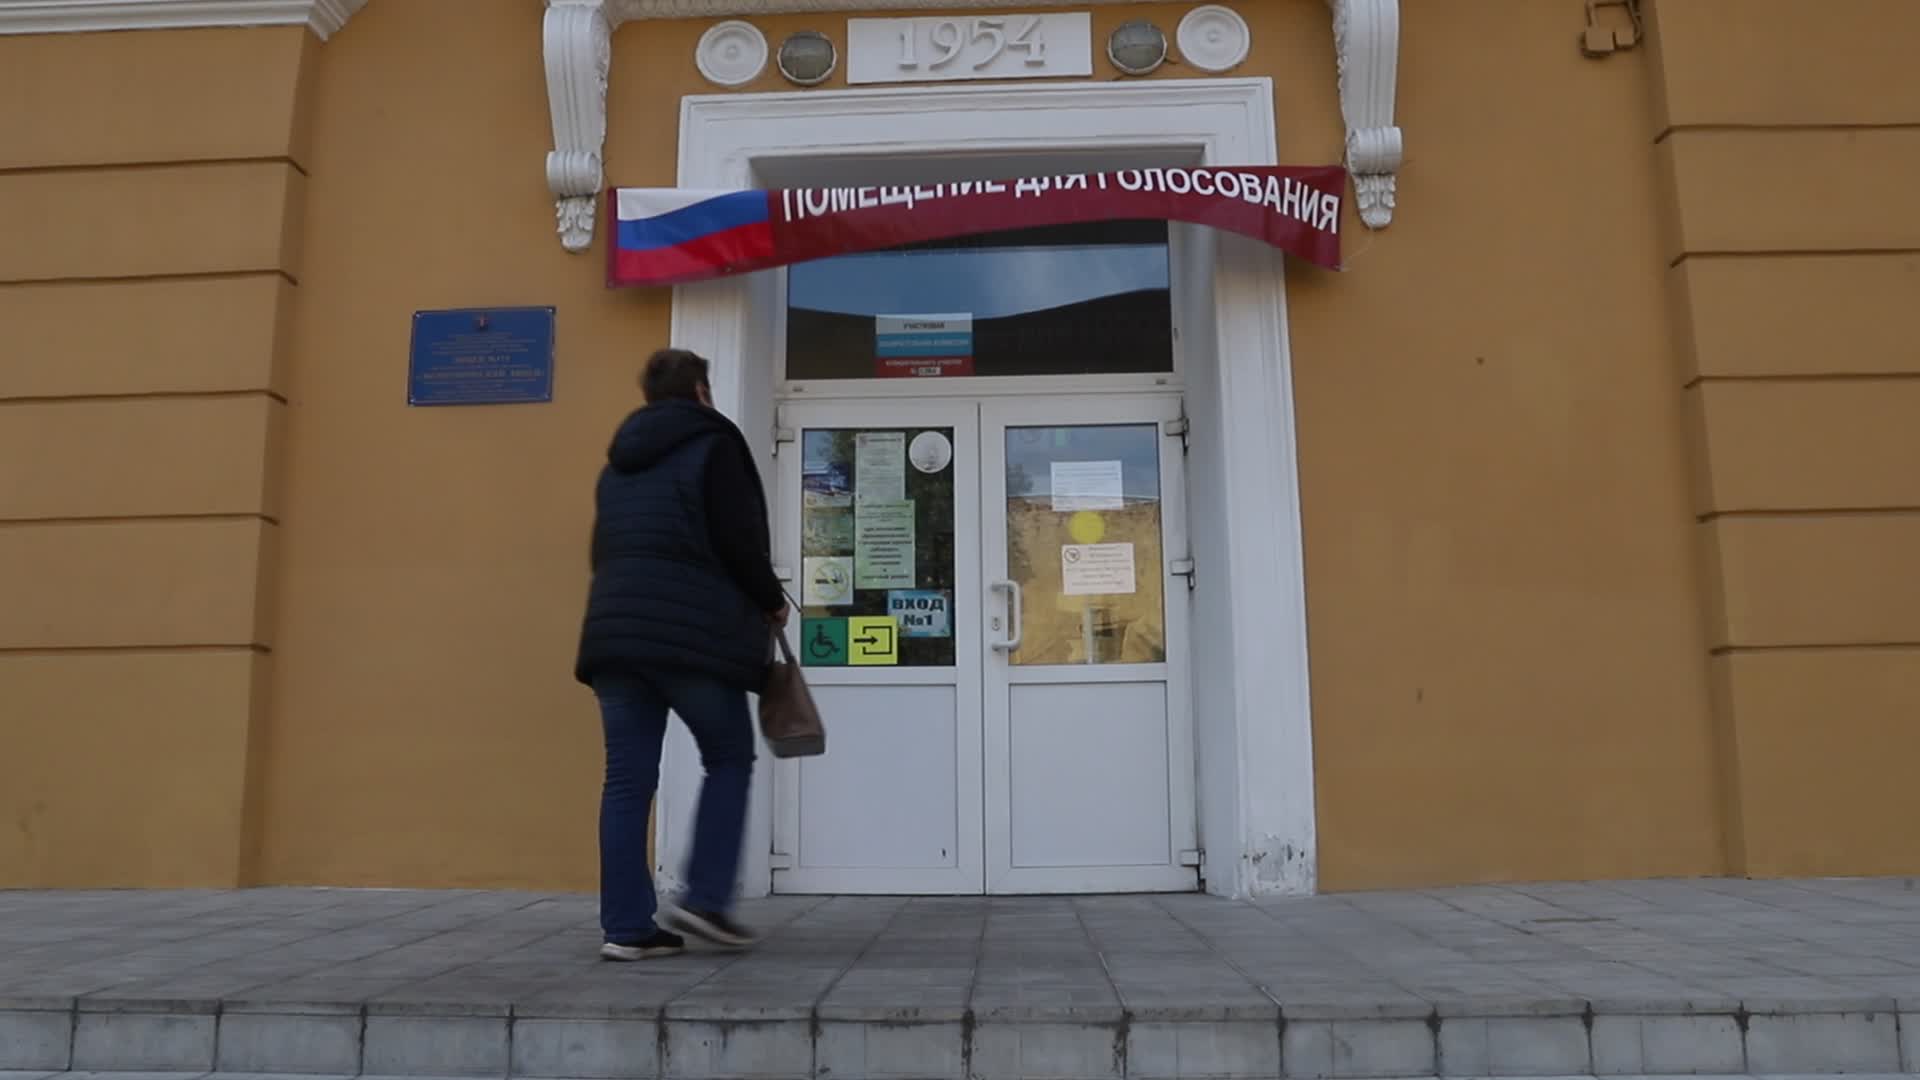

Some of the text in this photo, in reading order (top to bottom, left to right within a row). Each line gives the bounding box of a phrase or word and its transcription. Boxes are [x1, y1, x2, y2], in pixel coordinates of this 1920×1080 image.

[896, 15, 1046, 70] 1954
[892, 598, 944, 612] ВХОД
[903, 614, 933, 626] №1
